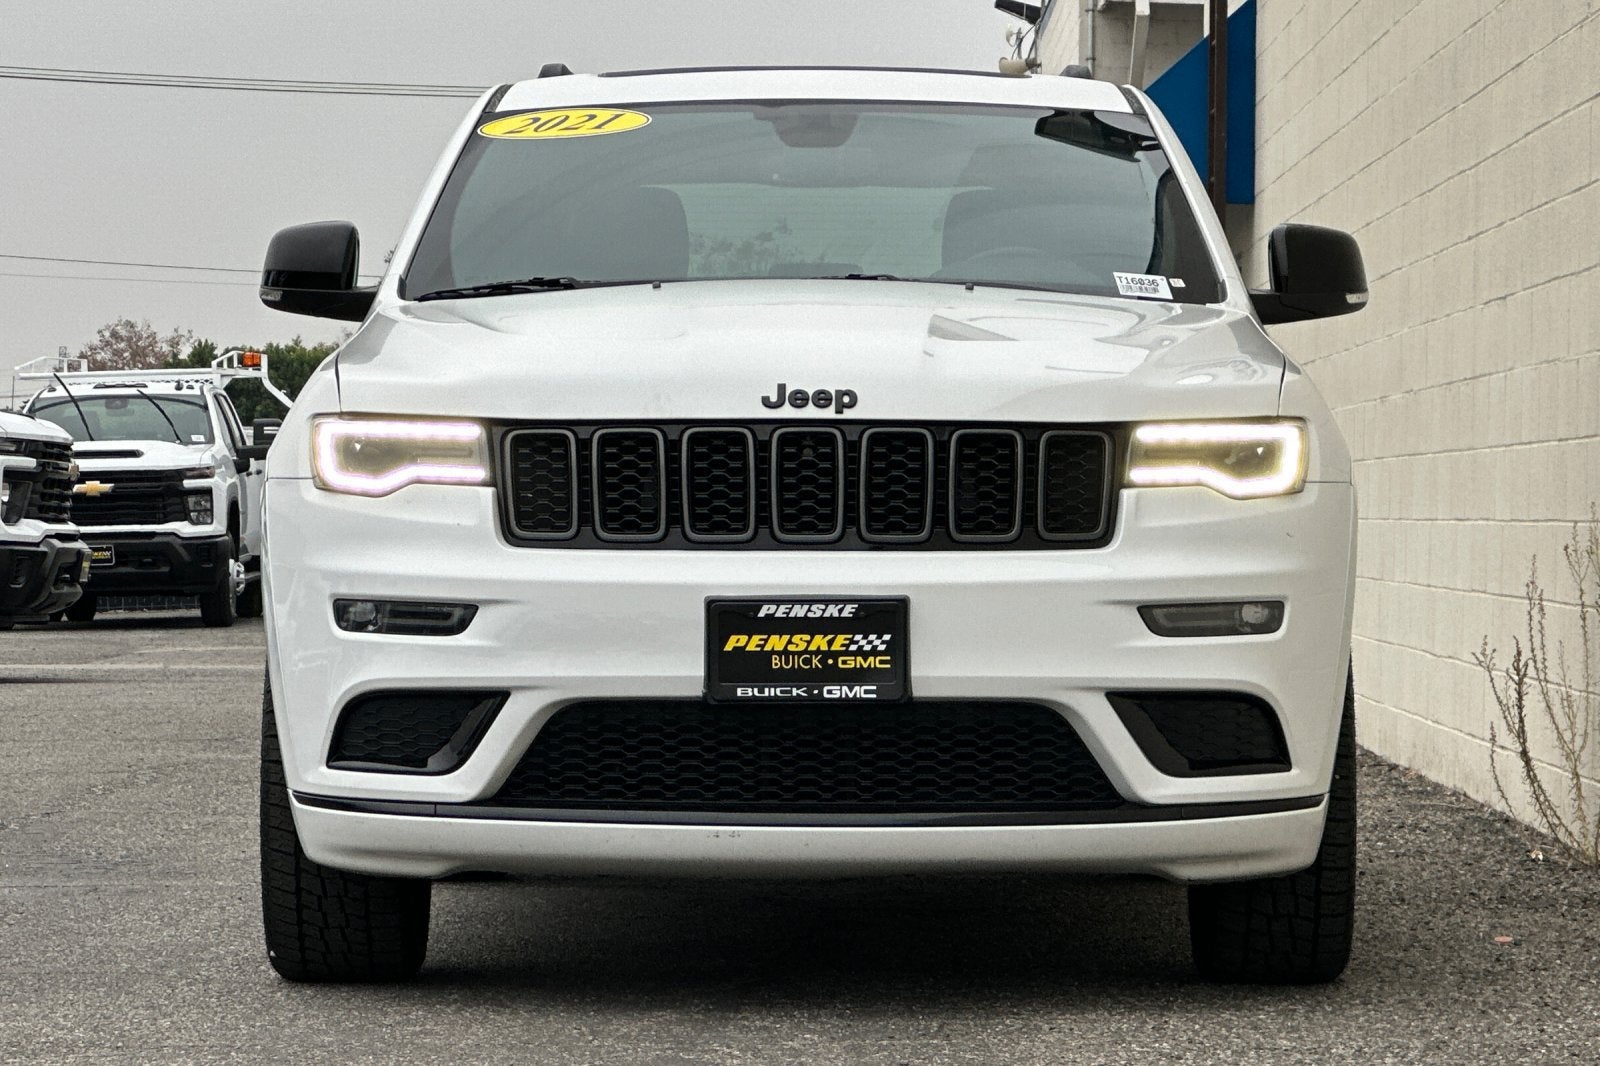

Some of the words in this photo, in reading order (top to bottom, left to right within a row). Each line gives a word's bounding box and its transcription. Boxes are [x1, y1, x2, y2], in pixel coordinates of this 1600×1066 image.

[502, 113, 626, 135] 2021
[1116, 275, 1160, 287] T16036
[761, 383, 858, 414] Jeep
[757, 604, 859, 618] PENSKE
[723, 634, 853, 652] PENSKE
[771, 655, 823, 669] BUICK
[837, 656, 892, 669] GMC
[736, 687, 808, 697] BUICK
[822, 686, 878, 698] GMC
